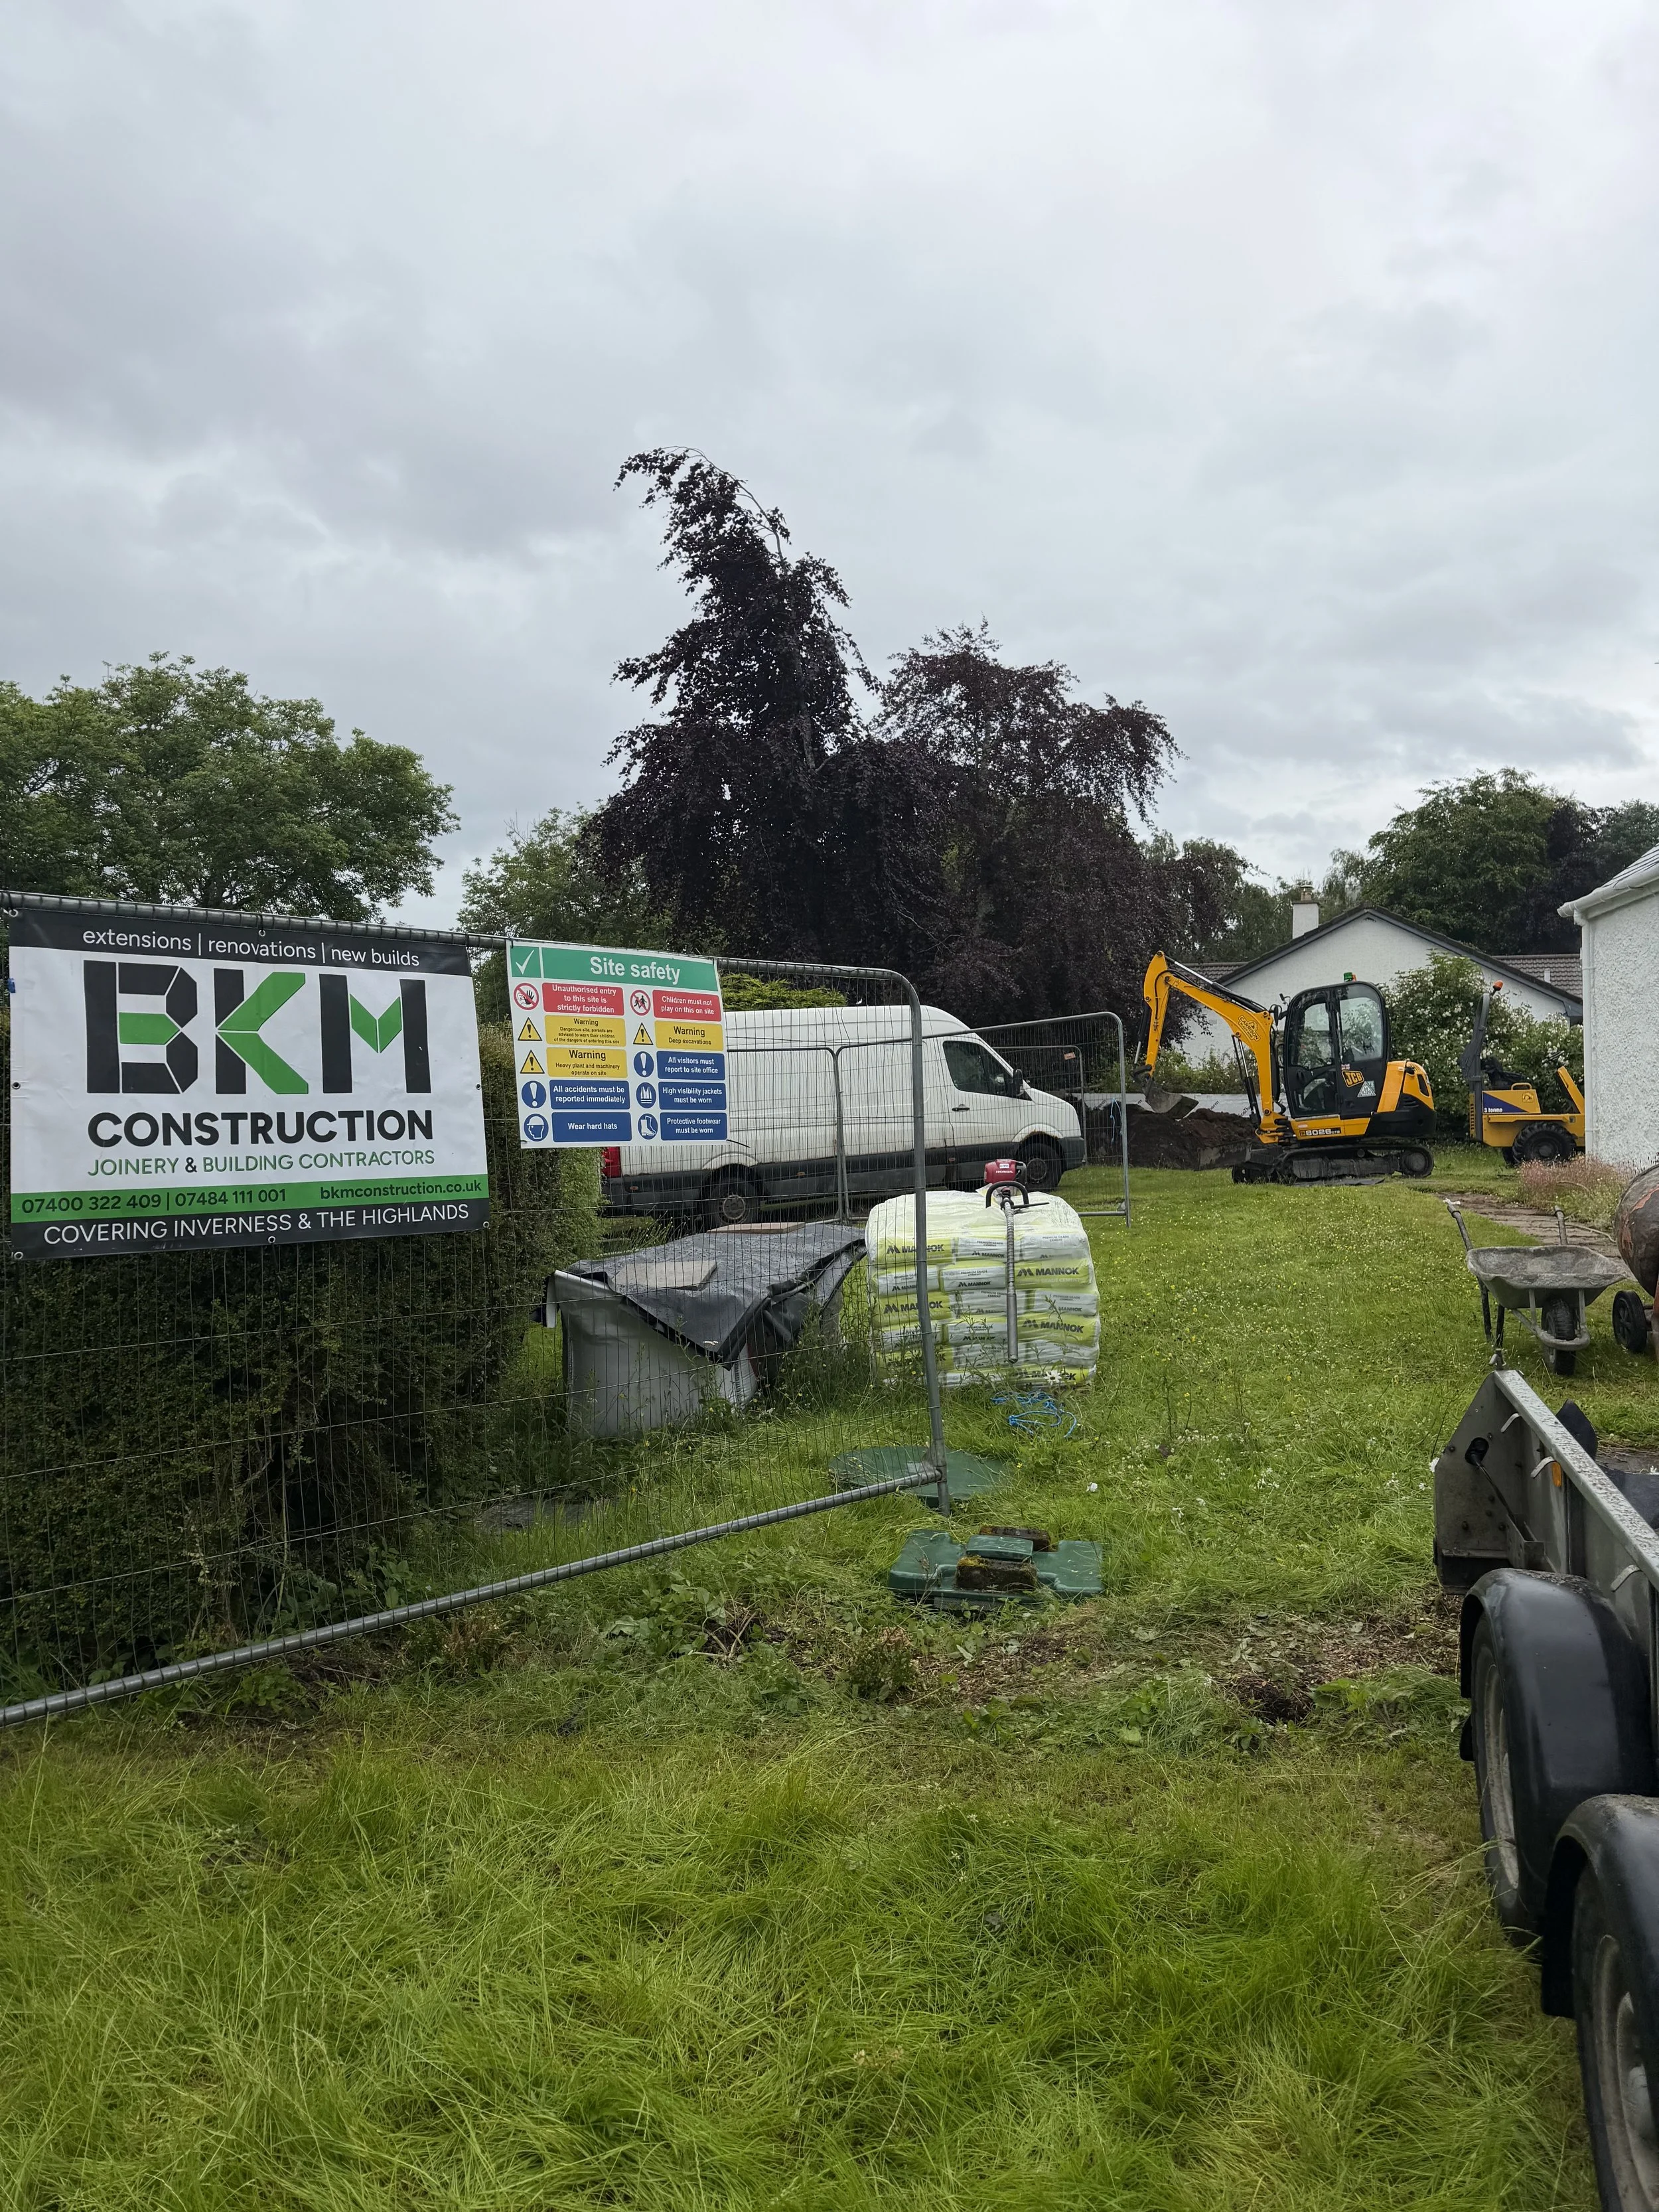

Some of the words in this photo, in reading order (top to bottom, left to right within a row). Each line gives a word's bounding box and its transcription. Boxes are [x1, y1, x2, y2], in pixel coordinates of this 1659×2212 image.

[82, 928, 191, 951] extensions
[208, 938, 317, 960] renovations
[331, 947, 366, 962] new
[371, 948, 420, 967] builds
[590, 956, 625, 976] Site
[630, 962, 680, 985] safety
[552, 984, 598, 994] Unauthorised
[662, 995, 686, 1004] Children
[557, 1004, 581, 1013] strictly
[583, 1005, 614, 1013] forbidden
[84, 960, 432, 1095] BKM
[573, 1018, 599, 1027] Warning
[674, 1026, 705, 1037] Warning
[1240, 1017, 1259, 1040] CARRISON
[569, 1049, 606, 1061] Warning
[1345, 1072, 1362, 1086] JCB
[662, 1087, 677, 1096] High
[555, 1095, 585, 1104] reported
[586, 1095, 626, 1104] immediately
[87, 1109, 433, 1147] CONSTRUCTION
[87, 1157, 179, 1177] JOINERY
[184, 1157, 198, 1173] &
[202, 1154, 293, 1173] BUILDING
[299, 1149, 435, 1169] CONTRACTORS
[22, 1197, 84, 1214] 07400
[89, 1196, 121, 1211] 322
[126, 1194, 161, 1209] 409
[175, 1191, 228, 1207] 07484
[232, 1191, 253, 1204] 111
[257, 1189, 286, 1203] 001
[320, 1179, 482, 1200] bkmconstruction.co.uk
[44, 1220, 168, 1244] COVERING
[174, 1214, 291, 1238] INVERNESS
[298, 1213, 312, 1229] &
[316, 1210, 356, 1228] THE
[362, 1203, 469, 1226] HIGHLANDS
[1036, 1267, 1080, 1276] MANNOK
[901, 1301, 943, 1311] MAOK
[1041, 1322, 1084, 1333] MANNOK
